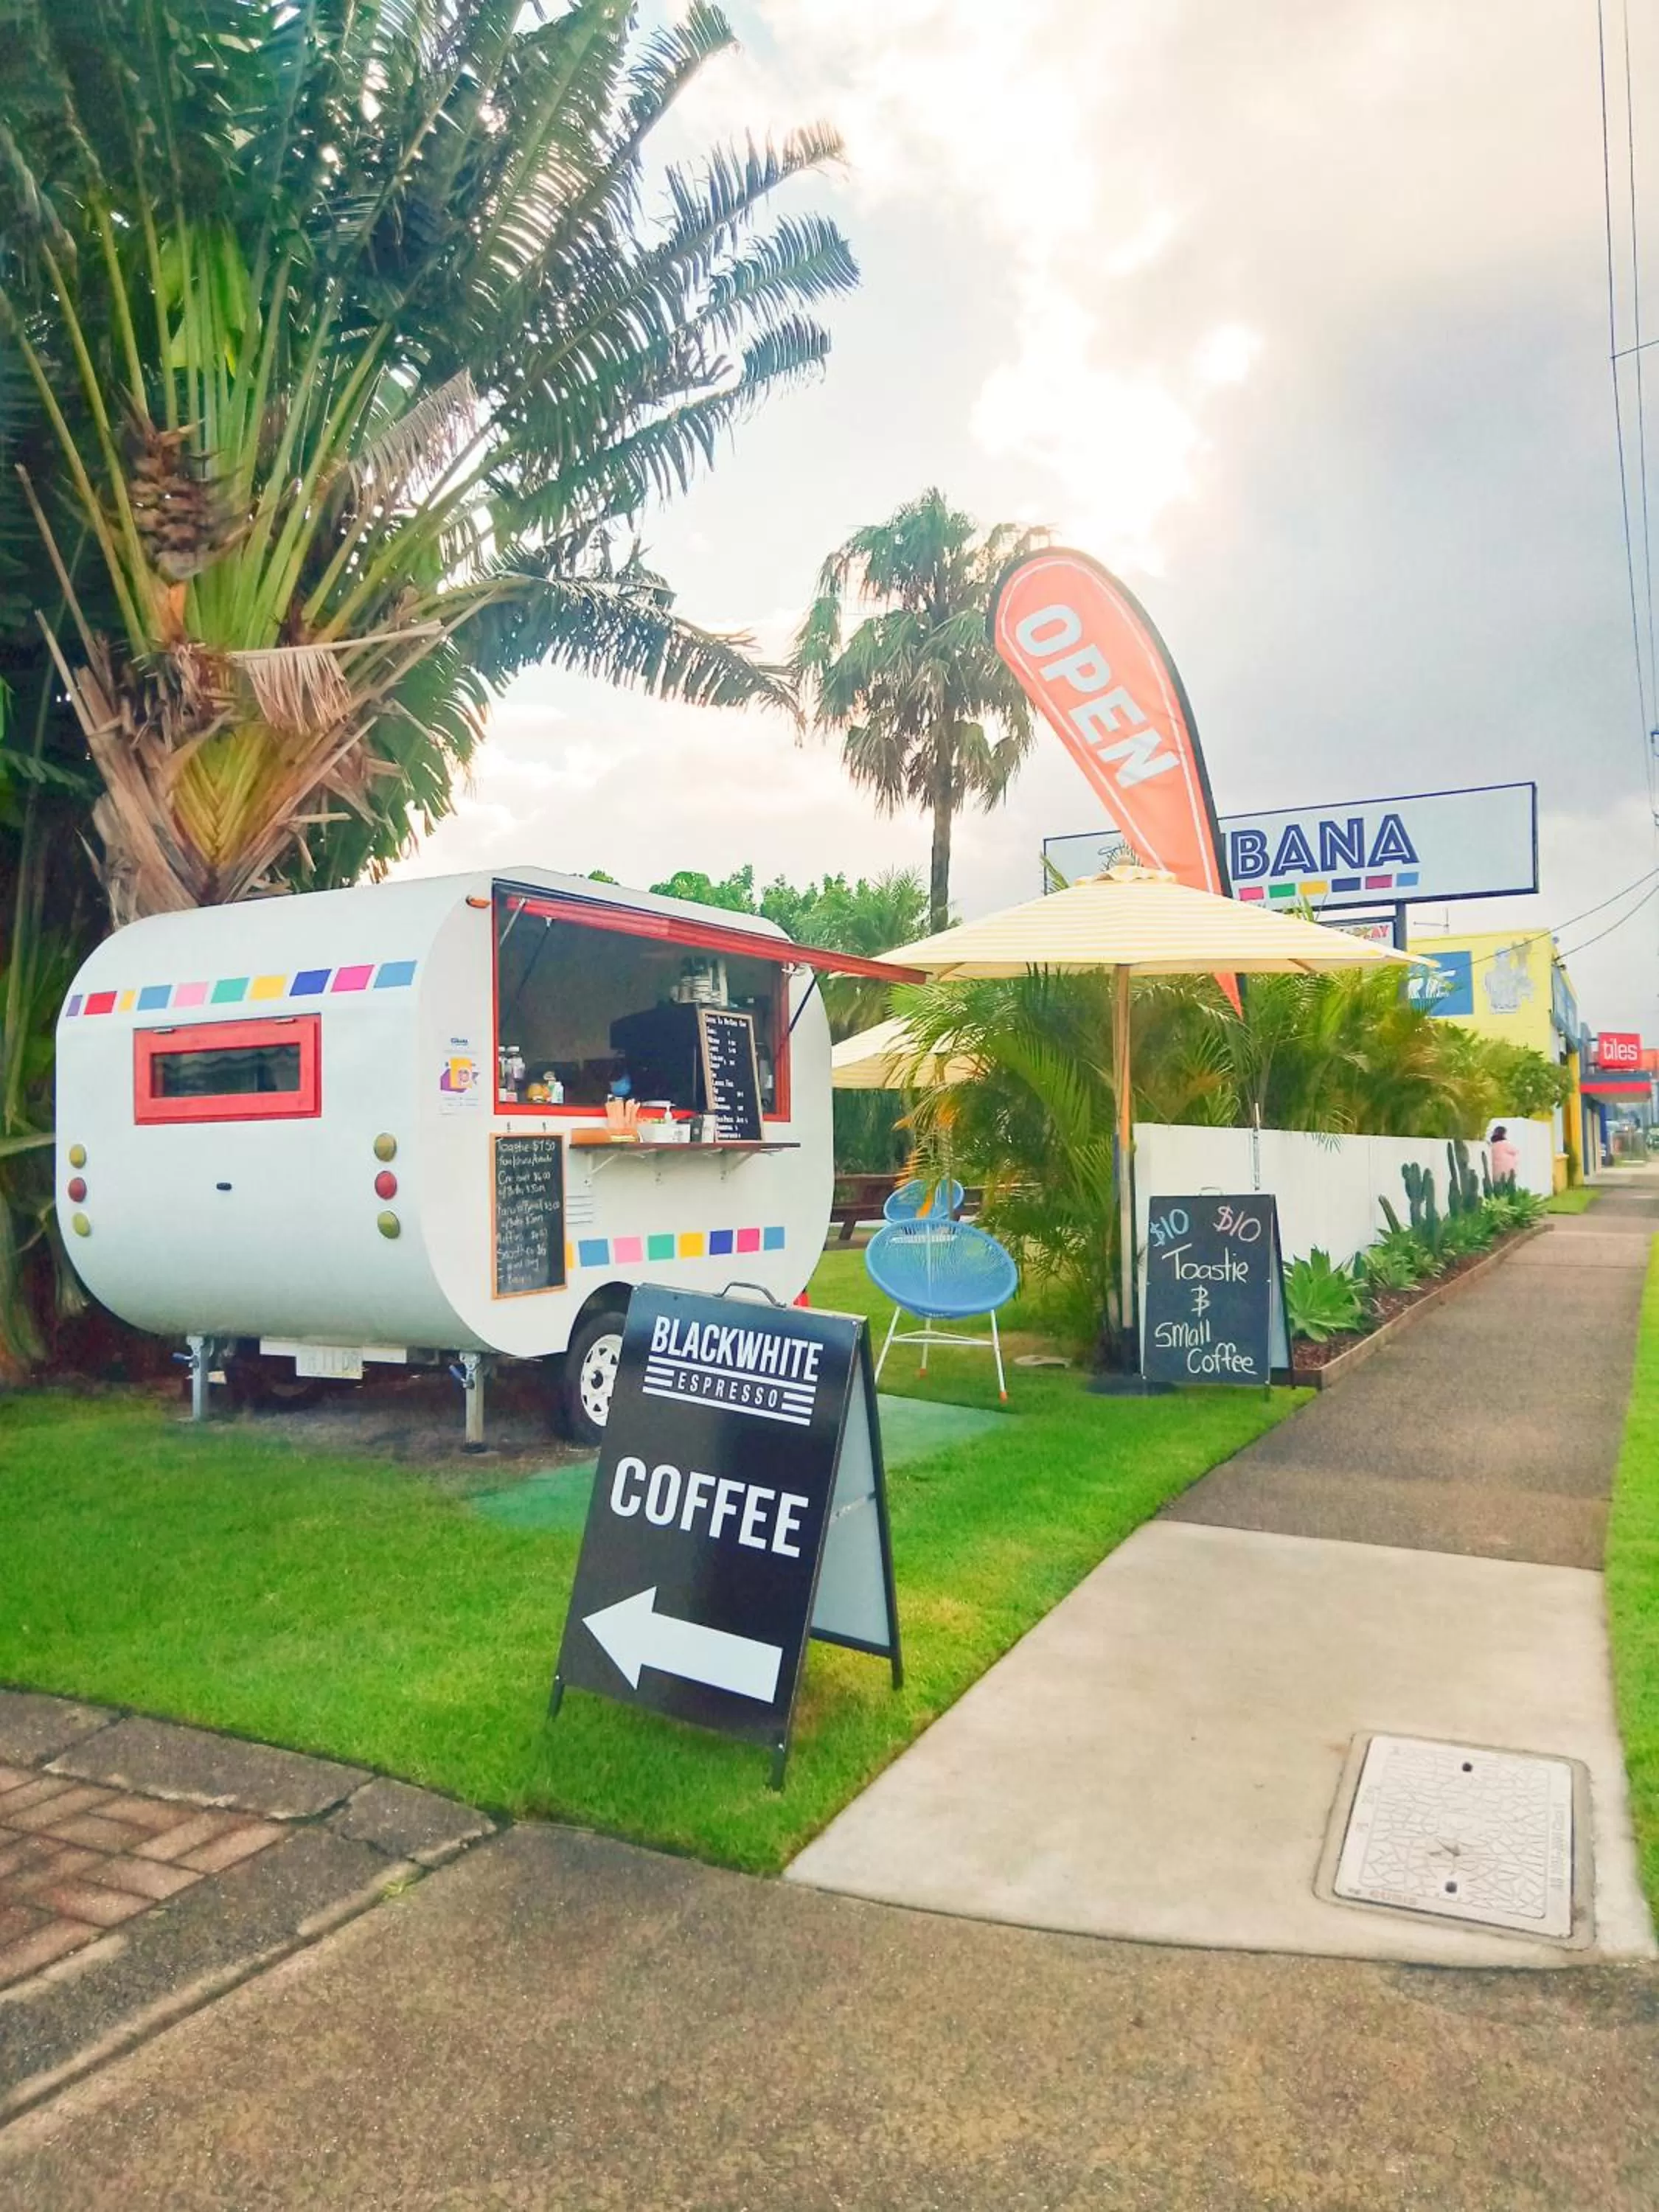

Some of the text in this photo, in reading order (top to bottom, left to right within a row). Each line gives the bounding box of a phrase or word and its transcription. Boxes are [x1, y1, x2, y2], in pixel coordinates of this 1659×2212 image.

[1015, 604, 1180, 788] OPEN
[1220, 813, 1419, 880] BANA
[1601, 1037, 1638, 1061] tiles
[1150, 1205, 1262, 1247] $10 $10
[1161, 1243, 1249, 1283] Toastie
[650, 1315, 824, 1382] BLACKWHITE
[1155, 1318, 1211, 1348] Small
[1186, 1342, 1258, 1375] Coffee
[677, 1371, 779, 1408] ESPRESSO
[610, 1456, 810, 1559] COFFEE
